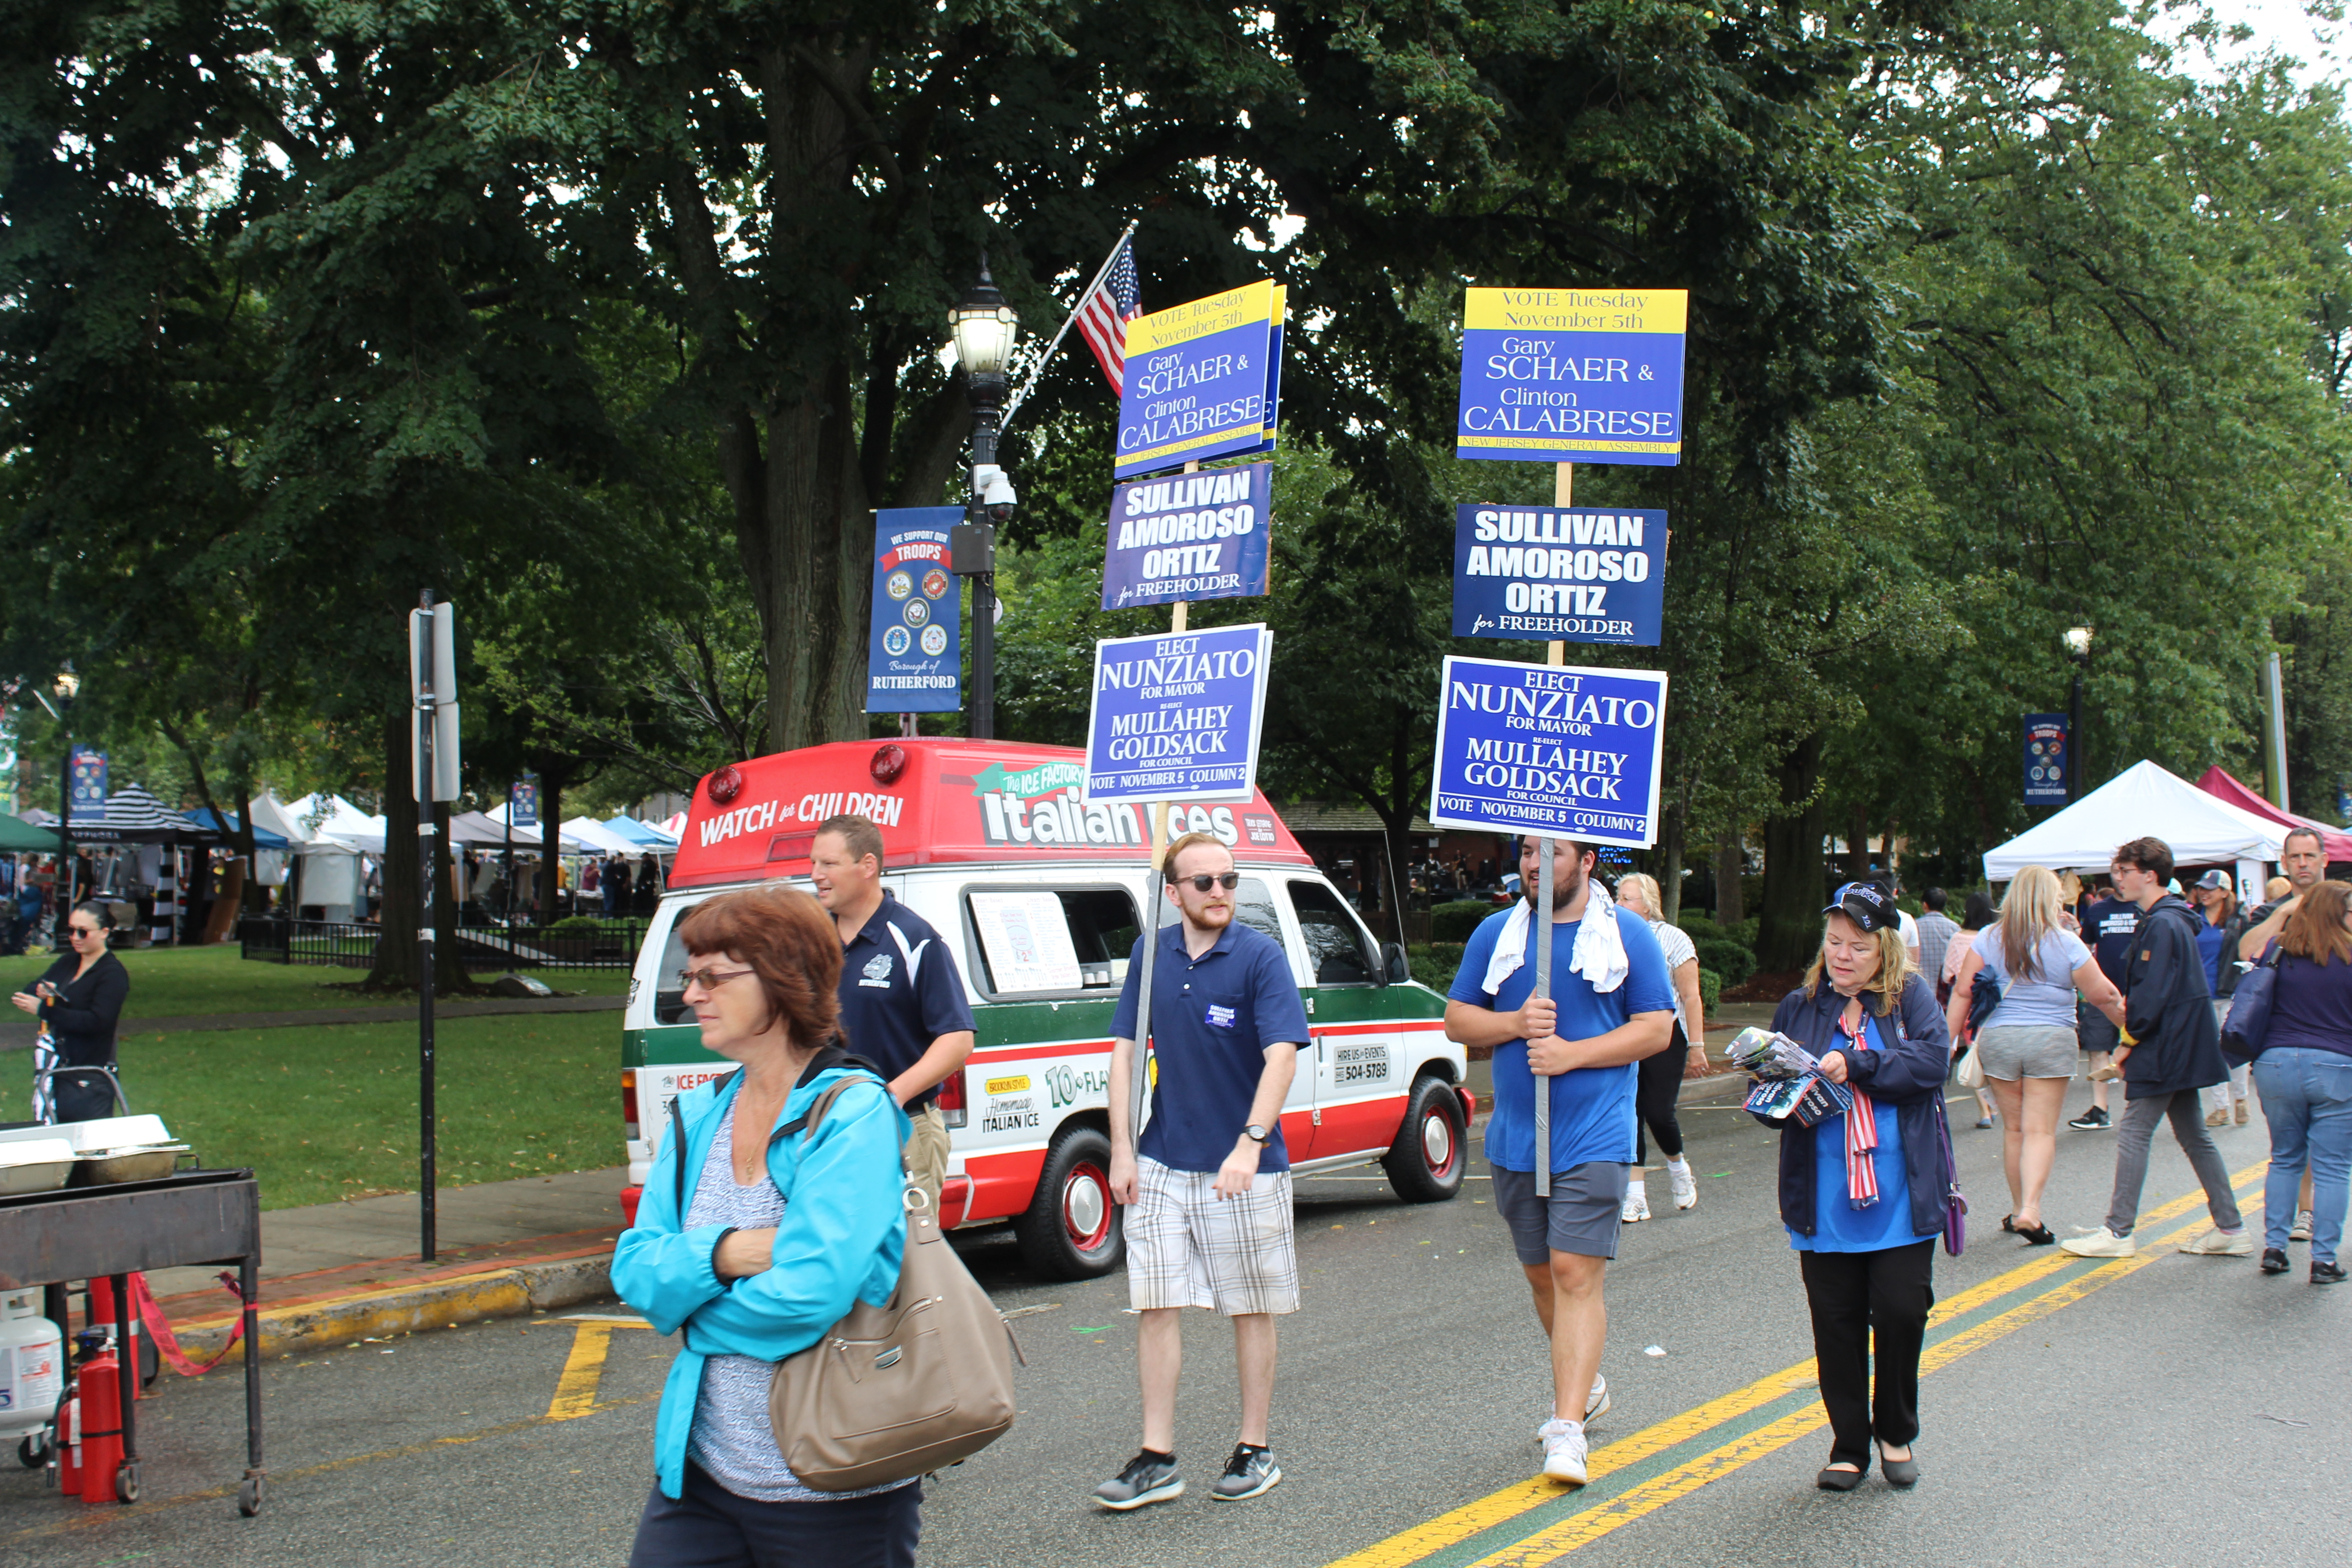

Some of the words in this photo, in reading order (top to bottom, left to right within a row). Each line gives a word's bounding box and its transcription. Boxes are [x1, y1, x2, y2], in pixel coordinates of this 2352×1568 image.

[1150, 307, 1186, 328] VOTE
[1191, 291, 1247, 317] Tuesday
[1503, 292, 1558, 307] VOTE
[1566, 292, 1648, 312] Tuesday
[1151, 319, 1217, 348] November
[1221, 311, 1242, 327] 5th
[1504, 312, 1605, 328] November
[1612, 314, 1643, 328] 5th
[1502, 337, 1555, 358] Gary
[1148, 352, 1183, 373] Gary
[1485, 355, 1629, 382] SCHAER
[1638, 364, 1654, 381] &
[1137, 354, 1232, 399] SCHAER
[1237, 354, 1249, 370] &
[1145, 396, 1196, 420] Clinton
[1500, 387, 1577, 407] Clinton
[1120, 395, 1260, 449] CALABRESE
[1464, 406, 1674, 436] CALABRESE
[1117, 454, 1137, 466] NEW
[1138, 446, 1169, 461] JERSEY
[1171, 436, 1211, 454] GENERAL
[1212, 425, 1259, 444] ASSEMBLY
[1463, 436, 1491, 446] NEW
[1493, 439, 1539, 449] JERSEY
[1543, 440, 1602, 451] GENERAL
[1606, 442, 1673, 453] ASSEMBLY
[1126, 470, 1251, 516] SULLIVAN
[891, 534, 903, 545] WE
[903, 530, 933, 542] SUPPORT
[933, 531, 948, 543] OUR
[1117, 504, 1254, 550] AMOROSO
[1475, 510, 1643, 546] SULLIVAN
[896, 544, 942, 561] TROOPS
[1142, 543, 1222, 579] ORTIZ
[1466, 546, 1648, 583] AMOROSO
[1117, 585, 1133, 606] for
[1135, 573, 1240, 597] FREEHOLDER
[1505, 582, 1607, 616] ORTIZ
[1471, 614, 1495, 635] for
[1499, 615, 1634, 636] FREEHOLDER
[1155, 637, 1200, 657] ELECT
[889, 661, 928, 675] Borough
[928, 660, 941, 674] of
[1100, 649, 1254, 691] NUNZIATO
[872, 676, 956, 690] RUTHERFORD
[1140, 687, 1162, 699] FOR
[1164, 682, 1205, 697] MAYOR
[1524, 671, 1583, 693] ELECT
[1450, 681, 1655, 729] NUNZIATO
[1110, 705, 1233, 737] MULLAHEY
[1505, 715, 1535, 731] FOR
[1538, 719, 1592, 737] MAYOR
[1109, 730, 1228, 760] GOLDSACK
[1533, 737, 1563, 746] RE-ELECT
[1139, 759, 1156, 768] FOR
[1157, 756, 1193, 767] COUNCIL
[1465, 737, 1629, 776] MULLAHEY
[1003, 775, 1020, 792] The
[1021, 772, 1039, 794] ICE
[1041, 764, 1083, 790] FACTORY
[1090, 776, 1115, 790] VOTE
[1120, 772, 1176, 788] NOVEMBER
[1177, 771, 1185, 784] 5
[1190, 769, 1237, 783] COLUMN
[1238, 767, 1245, 780] 2
[1464, 763, 1622, 801] GOLDSACK
[1506, 790, 1528, 800] FOR
[1530, 793, 1578, 806] COUNCIL
[700, 800, 778, 848] WATCH
[779, 803, 795, 822] for
[798, 793, 904, 828] CHILDREN
[983, 786, 1142, 844] Italian
[1439, 796, 1474, 813] VOTE
[1480, 801, 1555, 823] NOVEMBER
[1558, 811, 1567, 823] 5
[1573, 813, 1634, 832] COLUMN
[1636, 820, 1645, 833] 2
[1338, 1050, 1351, 1062] HIRE
[1352, 1049, 1359, 1060] US
[1365, 1046, 1386, 1058] EVENTS
[677, 1075, 694, 1089] ICE
[1347, 1063, 1387, 1080] 504-5789
[989, 1080, 1011, 1093] BROOKLYN
[1011, 1078, 1026, 1090] STYLE
[1045, 1065, 1077, 1108] 10
[986, 1097, 1034, 1118] Homemade
[983, 1116, 1021, 1133] ITALIAN
[1024, 1113, 1039, 1127] ICE
